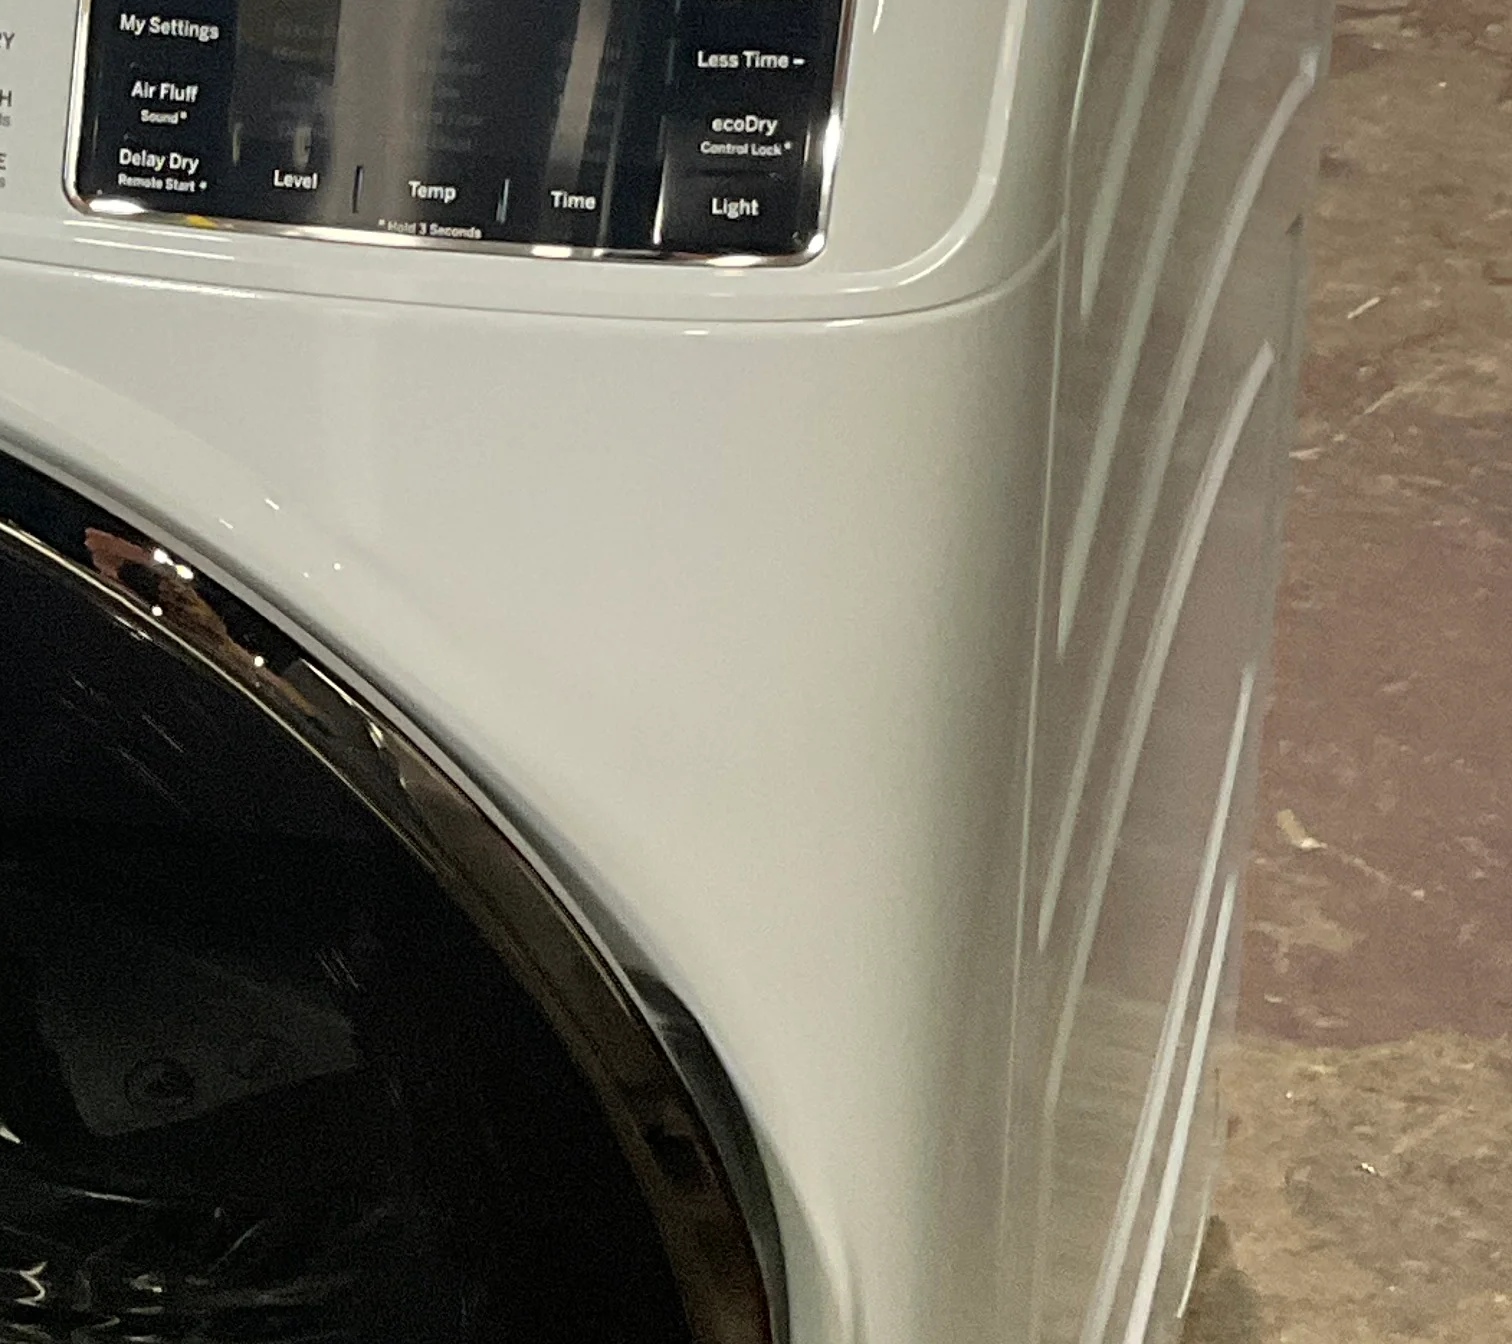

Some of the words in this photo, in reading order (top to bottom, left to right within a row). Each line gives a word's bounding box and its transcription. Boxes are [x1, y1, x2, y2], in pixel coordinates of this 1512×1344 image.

[119, 13, 147, 35] My
[148, 16, 220, 42] Settings
[697, 49, 739, 69] Less
[742, 49, 790, 69] Time
[130, 80, 159, 99] Air
[159, 82, 200, 103] Fluff
[711, 114, 779, 137] ecoDry
[700, 140, 749, 155] Control
[118, 147, 166, 171] Delay
[169, 152, 200, 175] Dry
[117, 173, 164, 190] Remote
[272, 169, 318, 190] Level
[407, 180, 457, 203] Temp
[550, 190, 597, 210] Time
[711, 197, 760, 219] Light
[429, 223, 483, 240] Seconds
